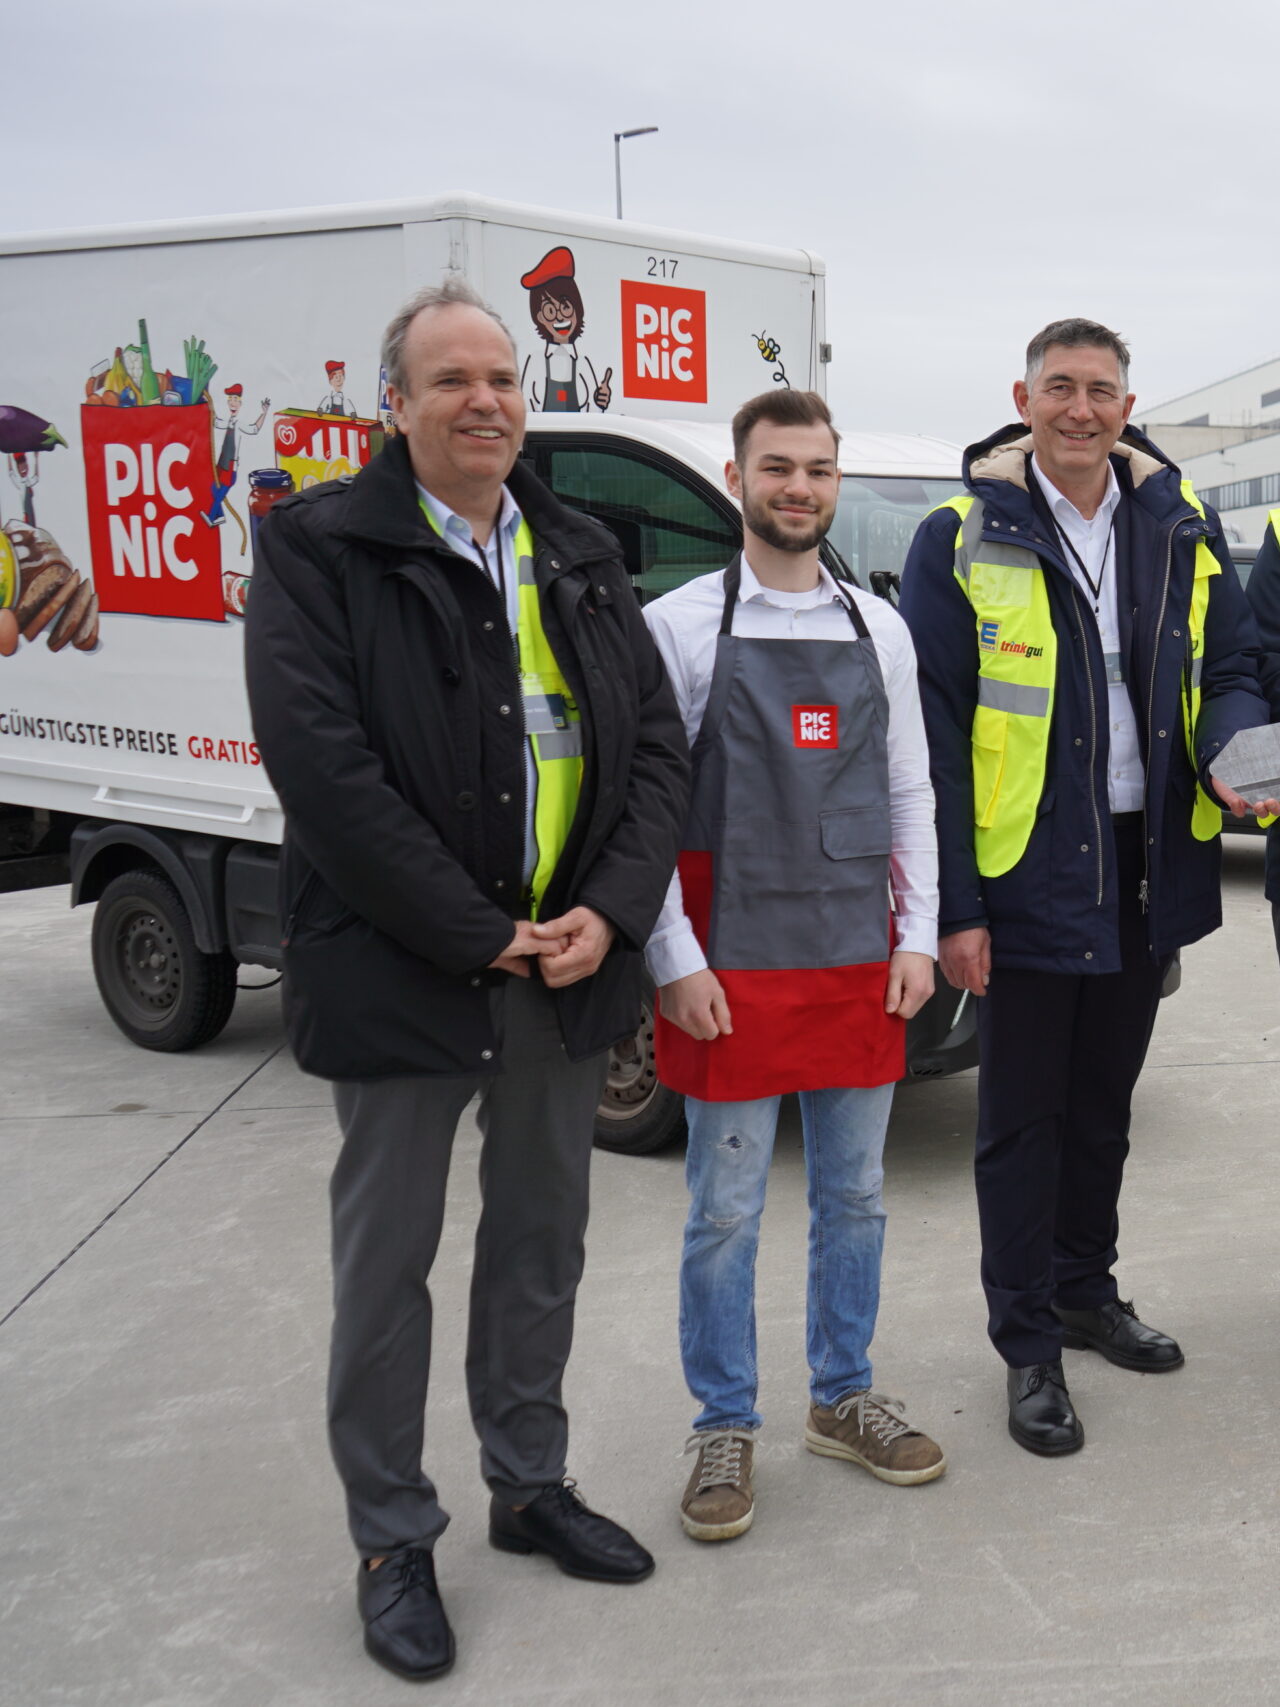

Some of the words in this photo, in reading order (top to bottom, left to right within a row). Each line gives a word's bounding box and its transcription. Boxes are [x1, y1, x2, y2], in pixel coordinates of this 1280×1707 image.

[647, 256, 679, 279] 217
[635, 303, 692, 344] PIC
[103, 442, 194, 510] PIC
[1000, 640, 1043, 658] trinkgut
[800, 712, 831, 727] PIC
[0, 708, 109, 747] GÜNSTIGSTE
[113, 727, 179, 756] PREISE
[188, 736, 261, 766] GRATIS
